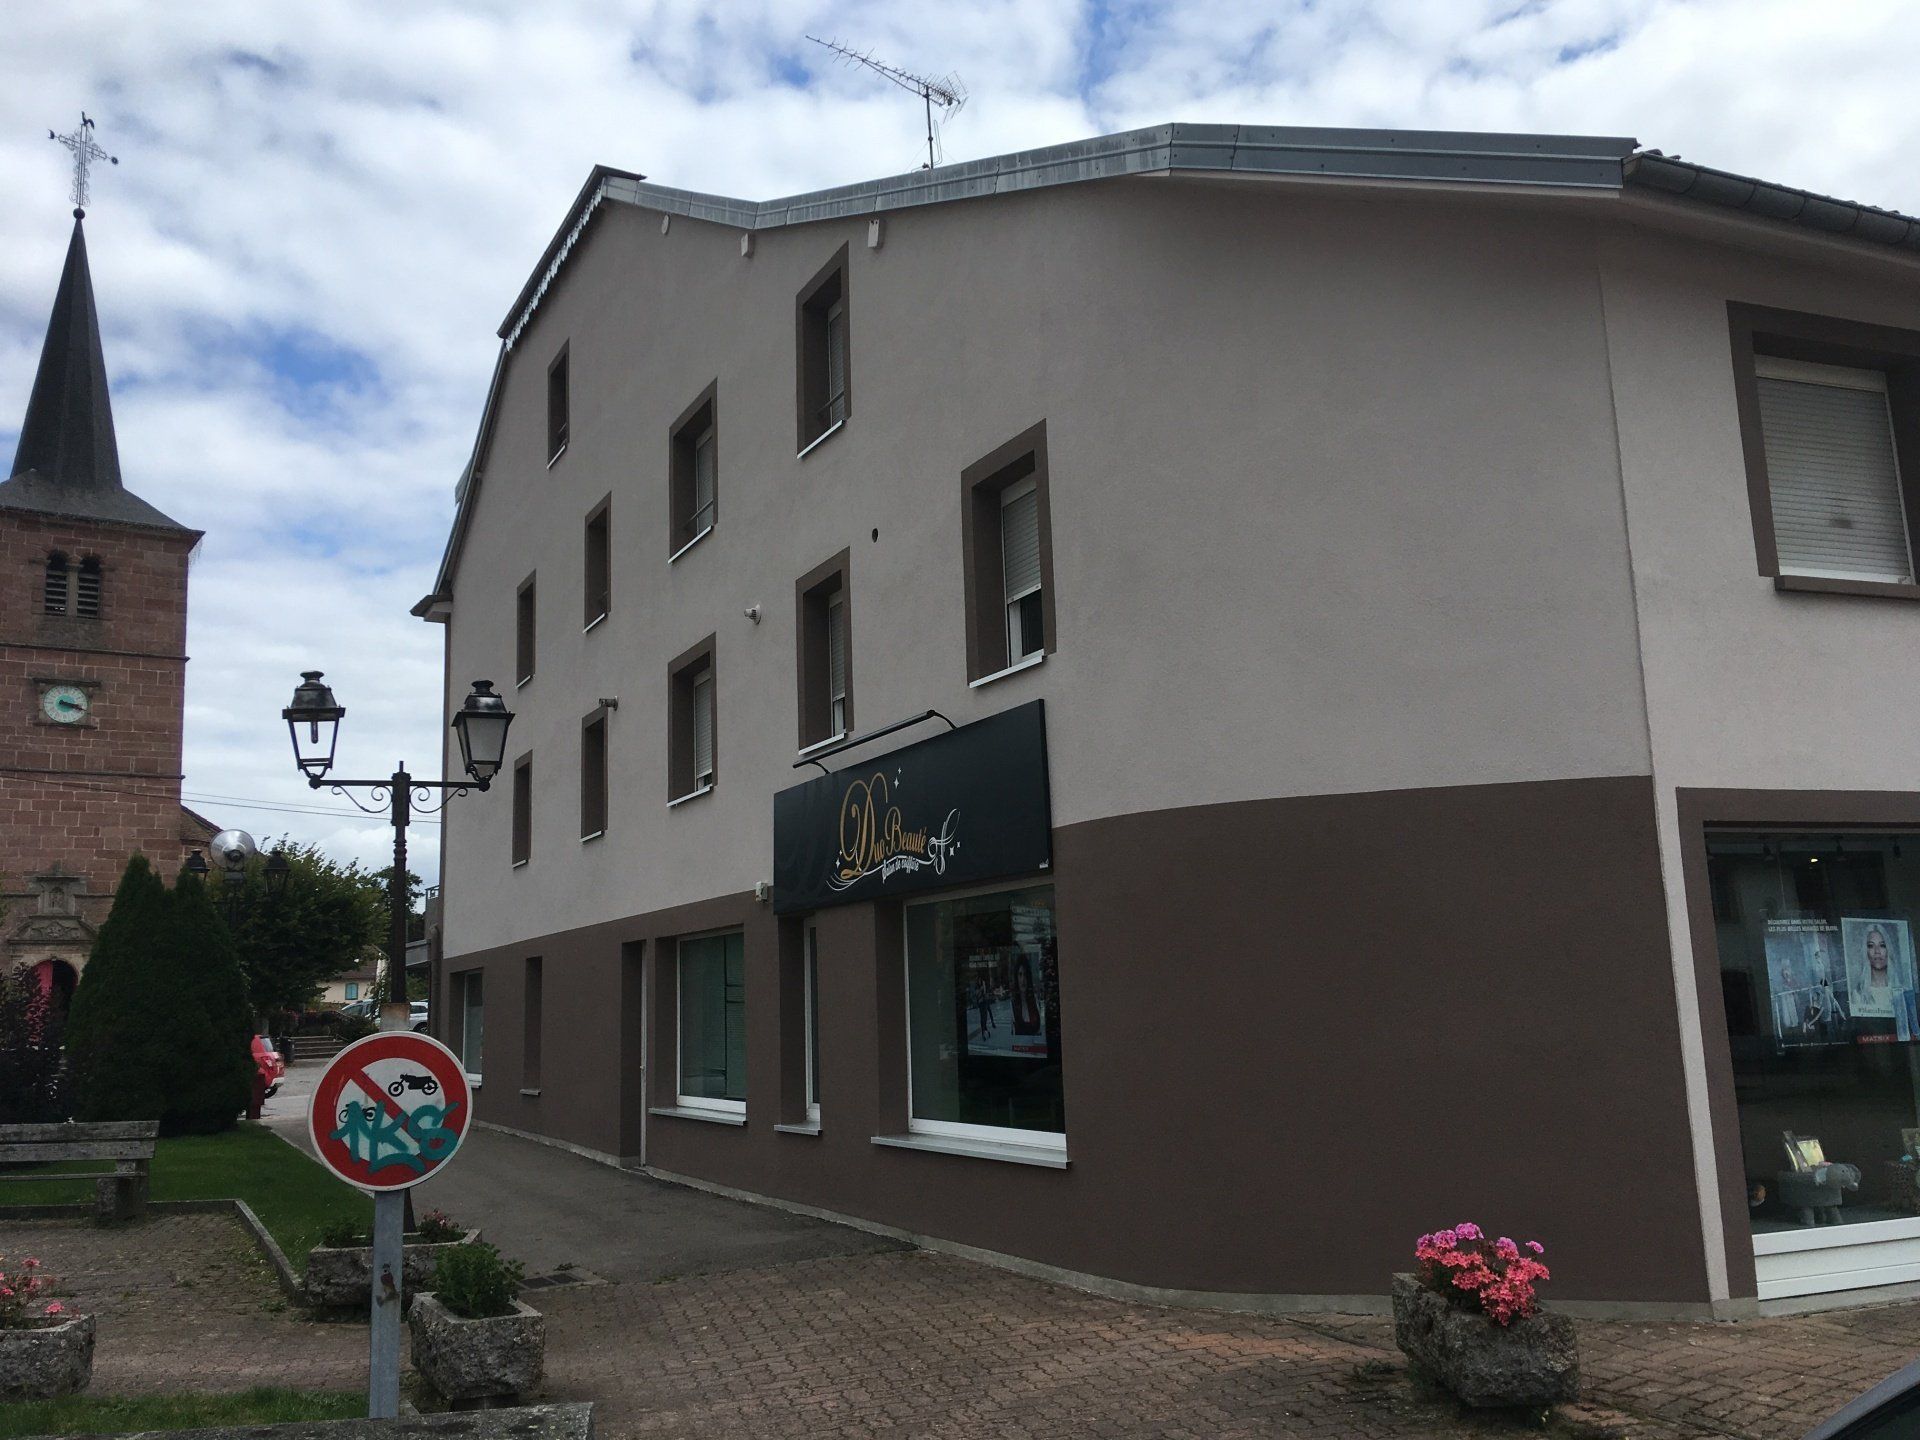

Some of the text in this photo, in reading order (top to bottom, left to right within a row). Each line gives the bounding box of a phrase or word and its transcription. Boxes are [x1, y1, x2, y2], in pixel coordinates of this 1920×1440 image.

[840, 772, 927, 880] Duo Beauté
[1862, 1034, 1890, 1042] MATRIX
